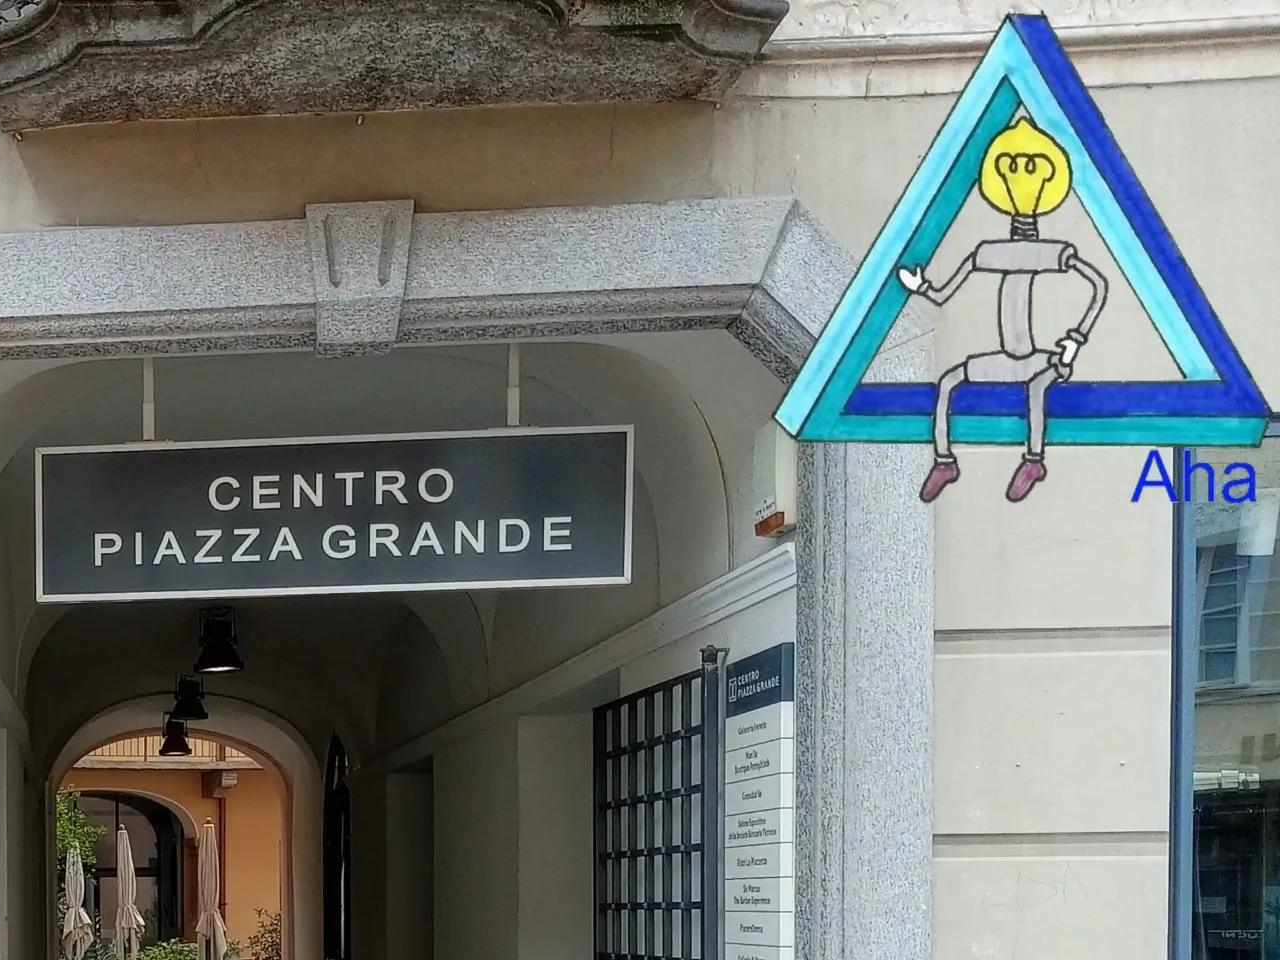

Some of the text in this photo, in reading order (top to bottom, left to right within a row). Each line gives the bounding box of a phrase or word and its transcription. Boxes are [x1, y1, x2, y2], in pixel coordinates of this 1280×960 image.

[208, 467, 455, 512] CENTRO
[93, 515, 574, 567] PIAZZA GRANDE
[737, 670, 760, 686] CENTRO
[737, 675, 780, 699] PIAZZA GRANDE
